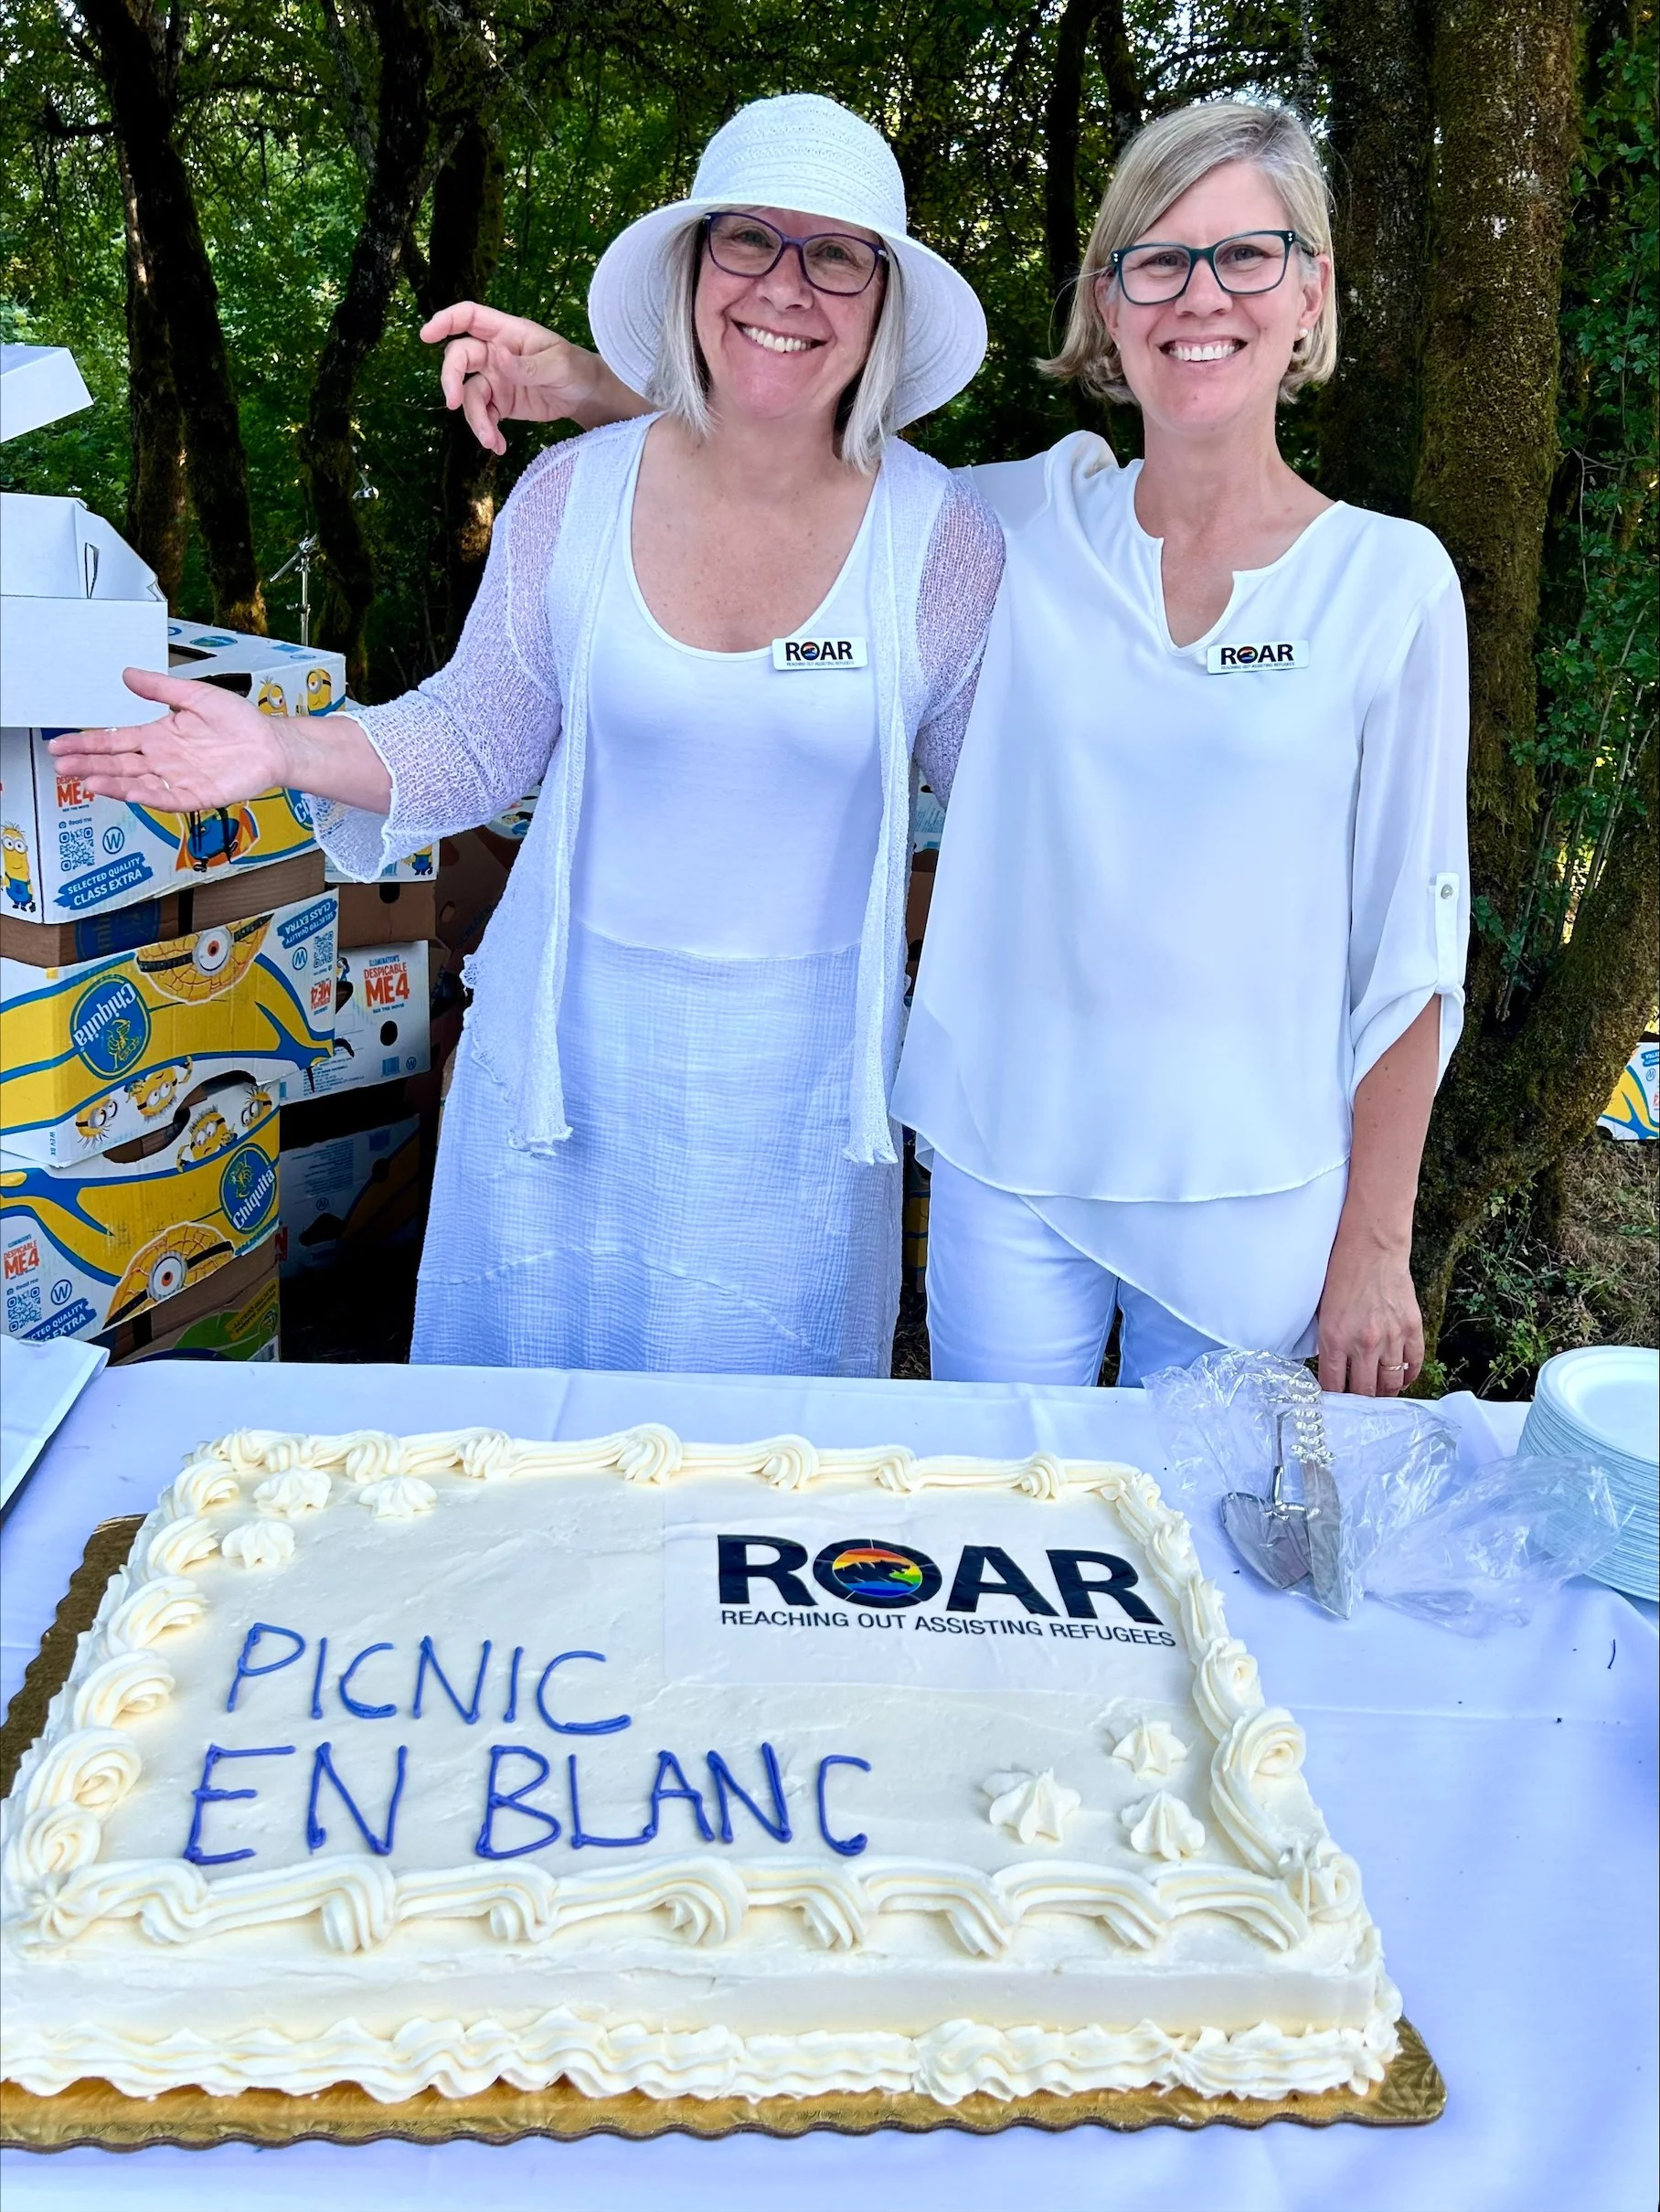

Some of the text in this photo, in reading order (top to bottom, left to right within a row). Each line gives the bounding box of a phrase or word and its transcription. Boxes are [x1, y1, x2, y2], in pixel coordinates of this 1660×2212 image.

[785, 642, 854, 661] ROAR
[1221, 644, 1293, 665] ROAR
[68, 857, 141, 894] SELECTED QUALITY
[73, 869, 143, 906] CLASS EXTRA
[285, 914, 310, 934] EXTRA
[364, 962, 407, 979] DESPICABLE
[73, 983, 137, 1047] Chiquita
[232, 1169, 275, 1229] Chiquita
[52, 1303, 84, 1327] QUALITY
[52, 1313, 87, 1337] EXTRA
[718, 1534, 1164, 1625] ROAR
[721, 1610, 1176, 1647] REACHING OUT ASSISTING REFUGEES
[226, 1622, 632, 1736] PICNIC
[183, 1741, 872, 1866] EN BLANC
